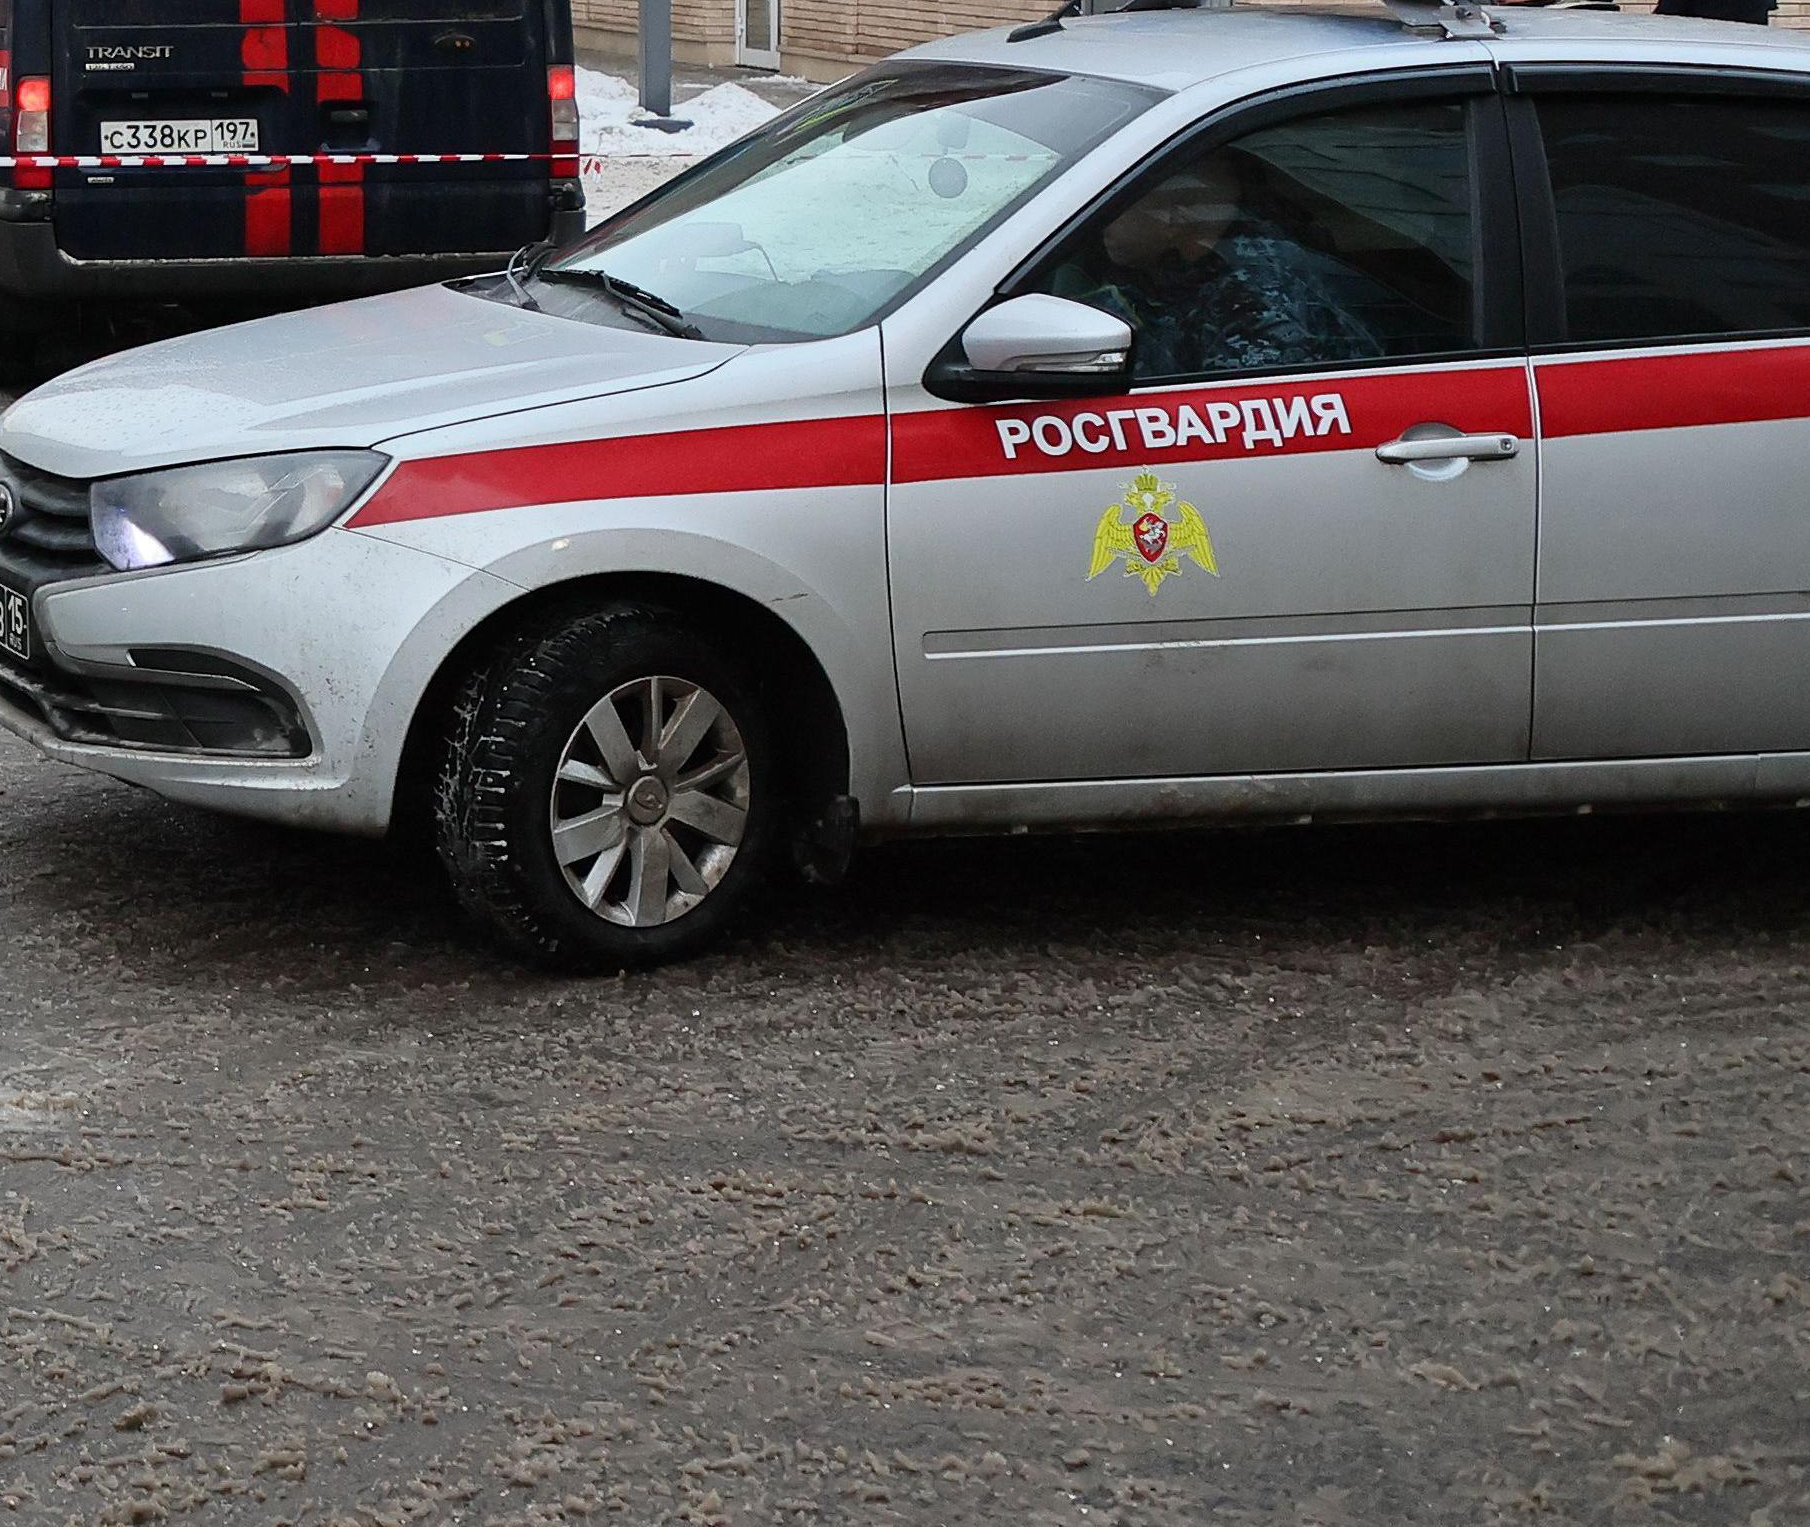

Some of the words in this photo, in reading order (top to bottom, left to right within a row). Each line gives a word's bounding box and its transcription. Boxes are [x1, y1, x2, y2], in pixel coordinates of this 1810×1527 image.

[85, 46, 174, 59] TRANSIT
[214, 122, 250, 141] 197
[995, 393, 1352, 459] РОСГВАРДИЯ
[8, 595, 23, 635] 15
